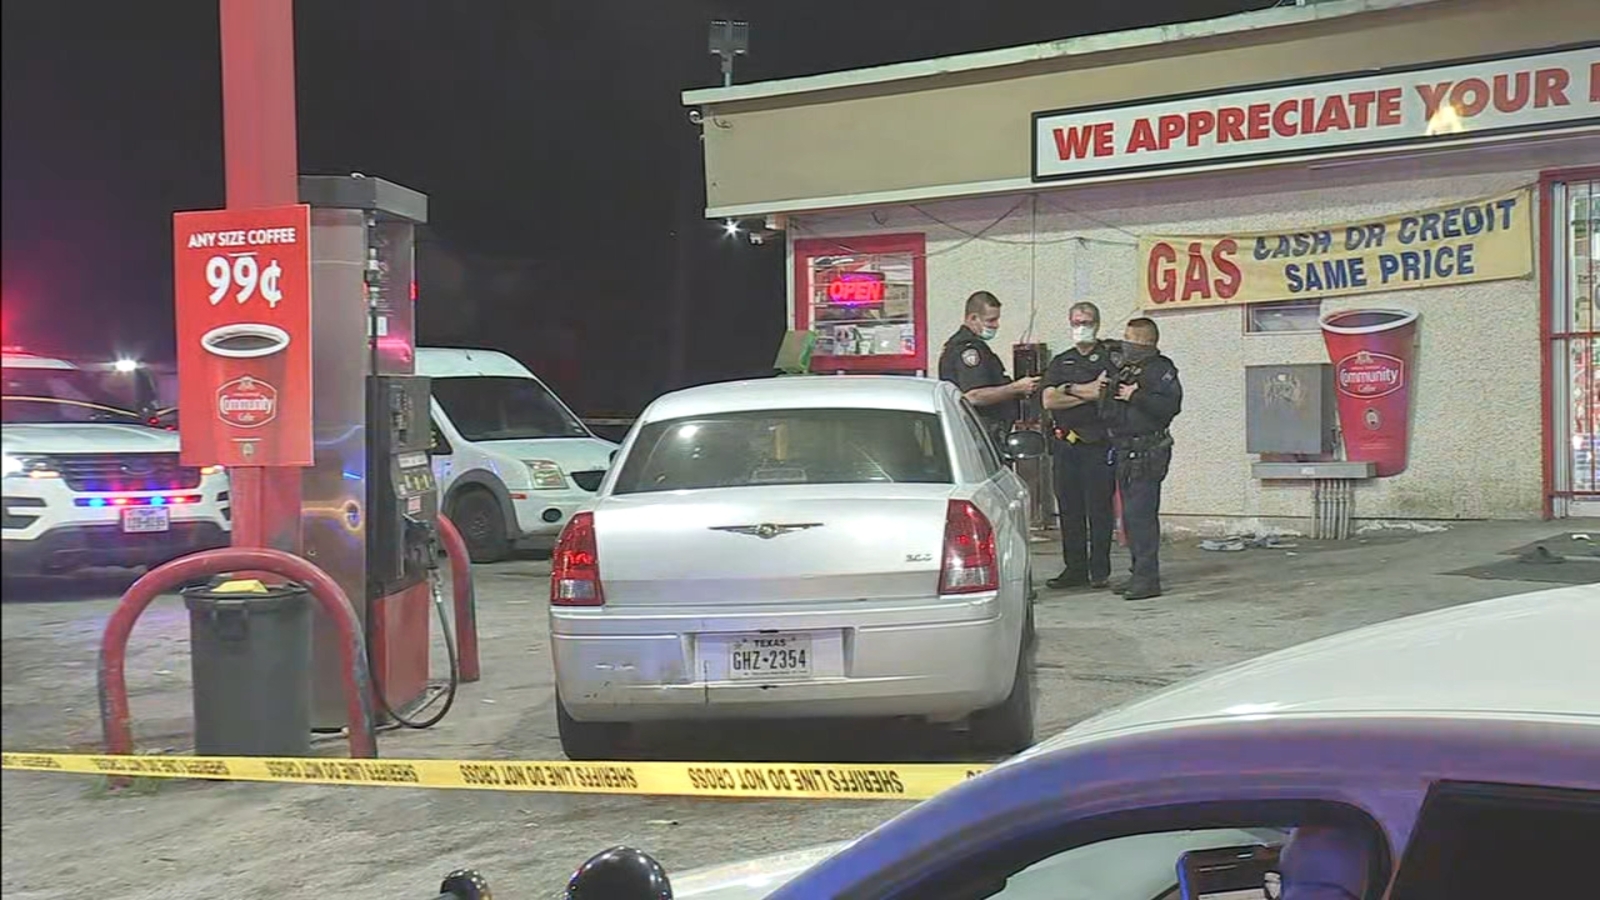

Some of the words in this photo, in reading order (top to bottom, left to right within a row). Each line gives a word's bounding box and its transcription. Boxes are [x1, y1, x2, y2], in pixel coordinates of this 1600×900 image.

[1053, 122, 1114, 161] WE
[1125, 86, 1402, 154] APPRECIATE
[1415, 67, 1571, 121] YOUR
[1397, 198, 1516, 245] CREDIT
[188, 232, 216, 248] ANY
[218, 230, 246, 247] SIZE
[248, 228, 296, 245] COFFEE
[1147, 238, 1242, 304] GAS
[1285, 257, 1367, 292] SAME
[1379, 244, 1474, 284] PRICE
[828, 280, 884, 302] OPEN
[753, 638, 787, 648] TEXAS
[688, 767, 735, 790] CROSS
[738, 768, 768, 790] NOT
[768, 768, 792, 791] DO
[795, 769, 829, 792] LINE
[827, 769, 905, 794] SHERIFFS
